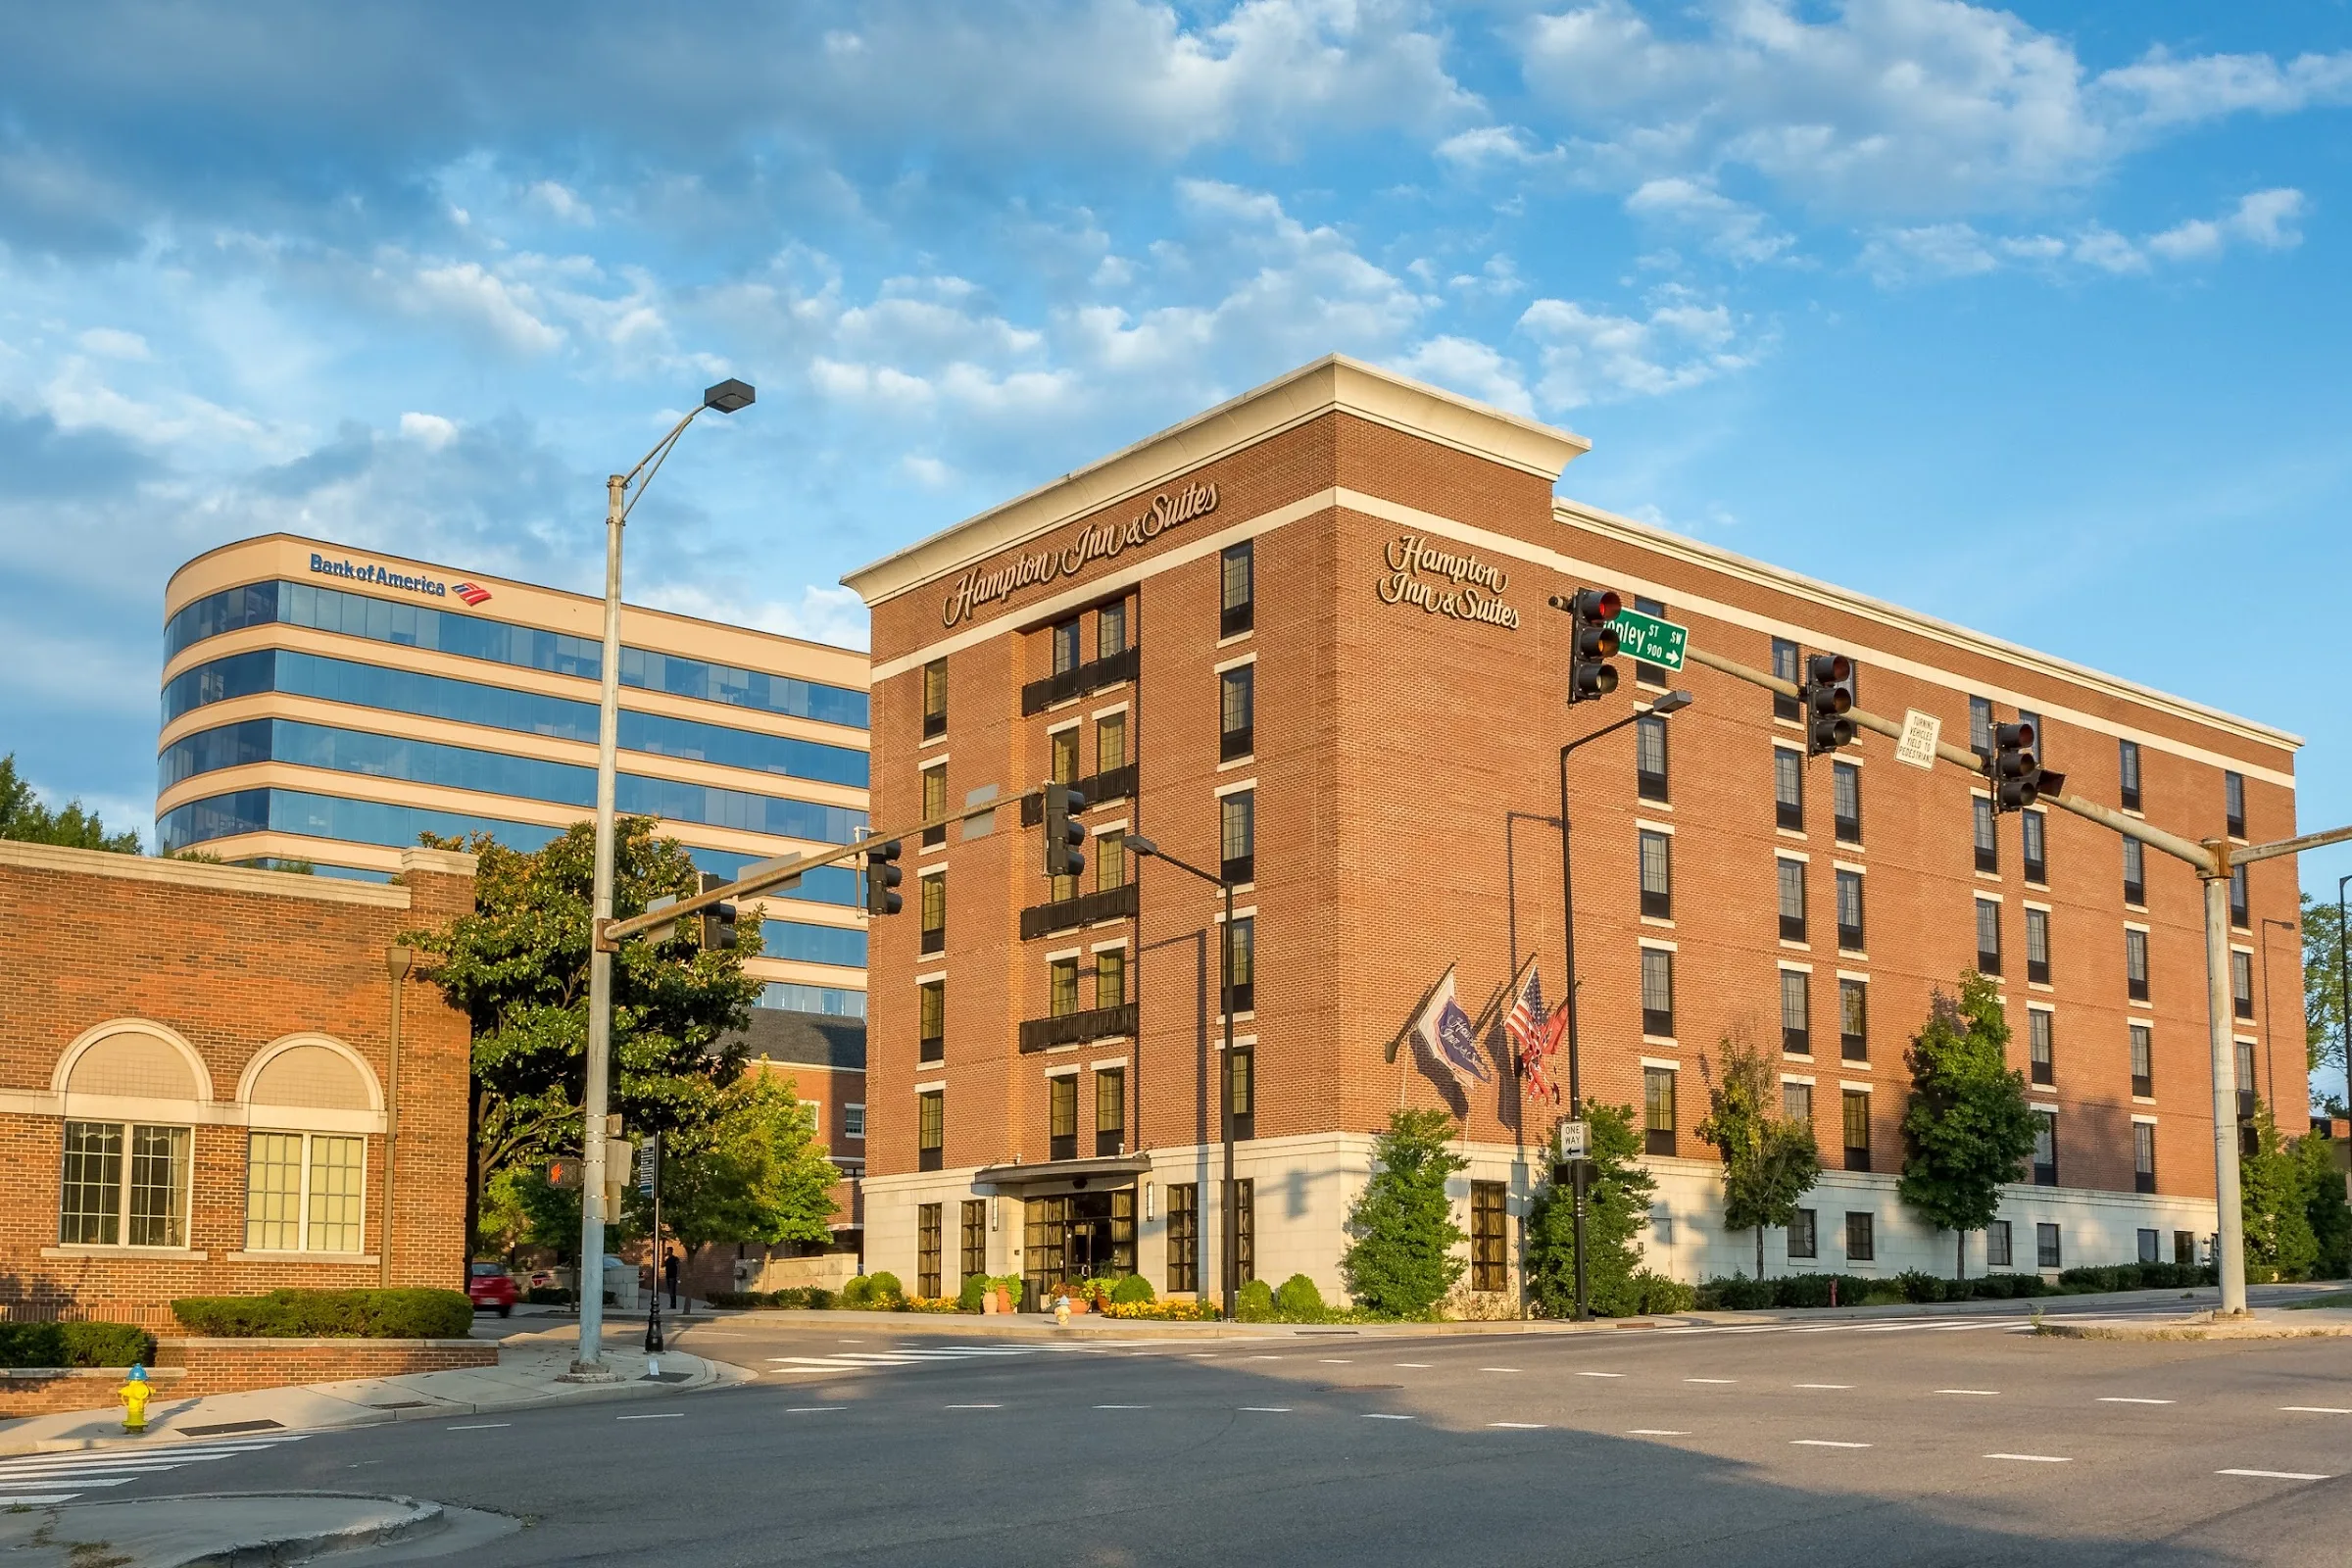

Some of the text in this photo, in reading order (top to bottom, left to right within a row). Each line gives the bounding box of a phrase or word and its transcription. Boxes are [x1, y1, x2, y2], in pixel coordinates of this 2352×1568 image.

[943, 481, 1219, 626] Hampton Inn & Suites
[1386, 535, 1508, 594] Hampton
[311, 553, 446, 597] Bank of America
[1378, 572, 1520, 629] Inn & Suites
[1603, 620, 1683, 653] nley ST SW
[1646, 643, 1663, 659] 900
[1907, 737, 1931, 752] YIELD TO
[1910, 726, 1933, 741] VEHICLES
[1565, 1125, 1580, 1134] ONE
[1565, 1136, 1581, 1145] WAY
